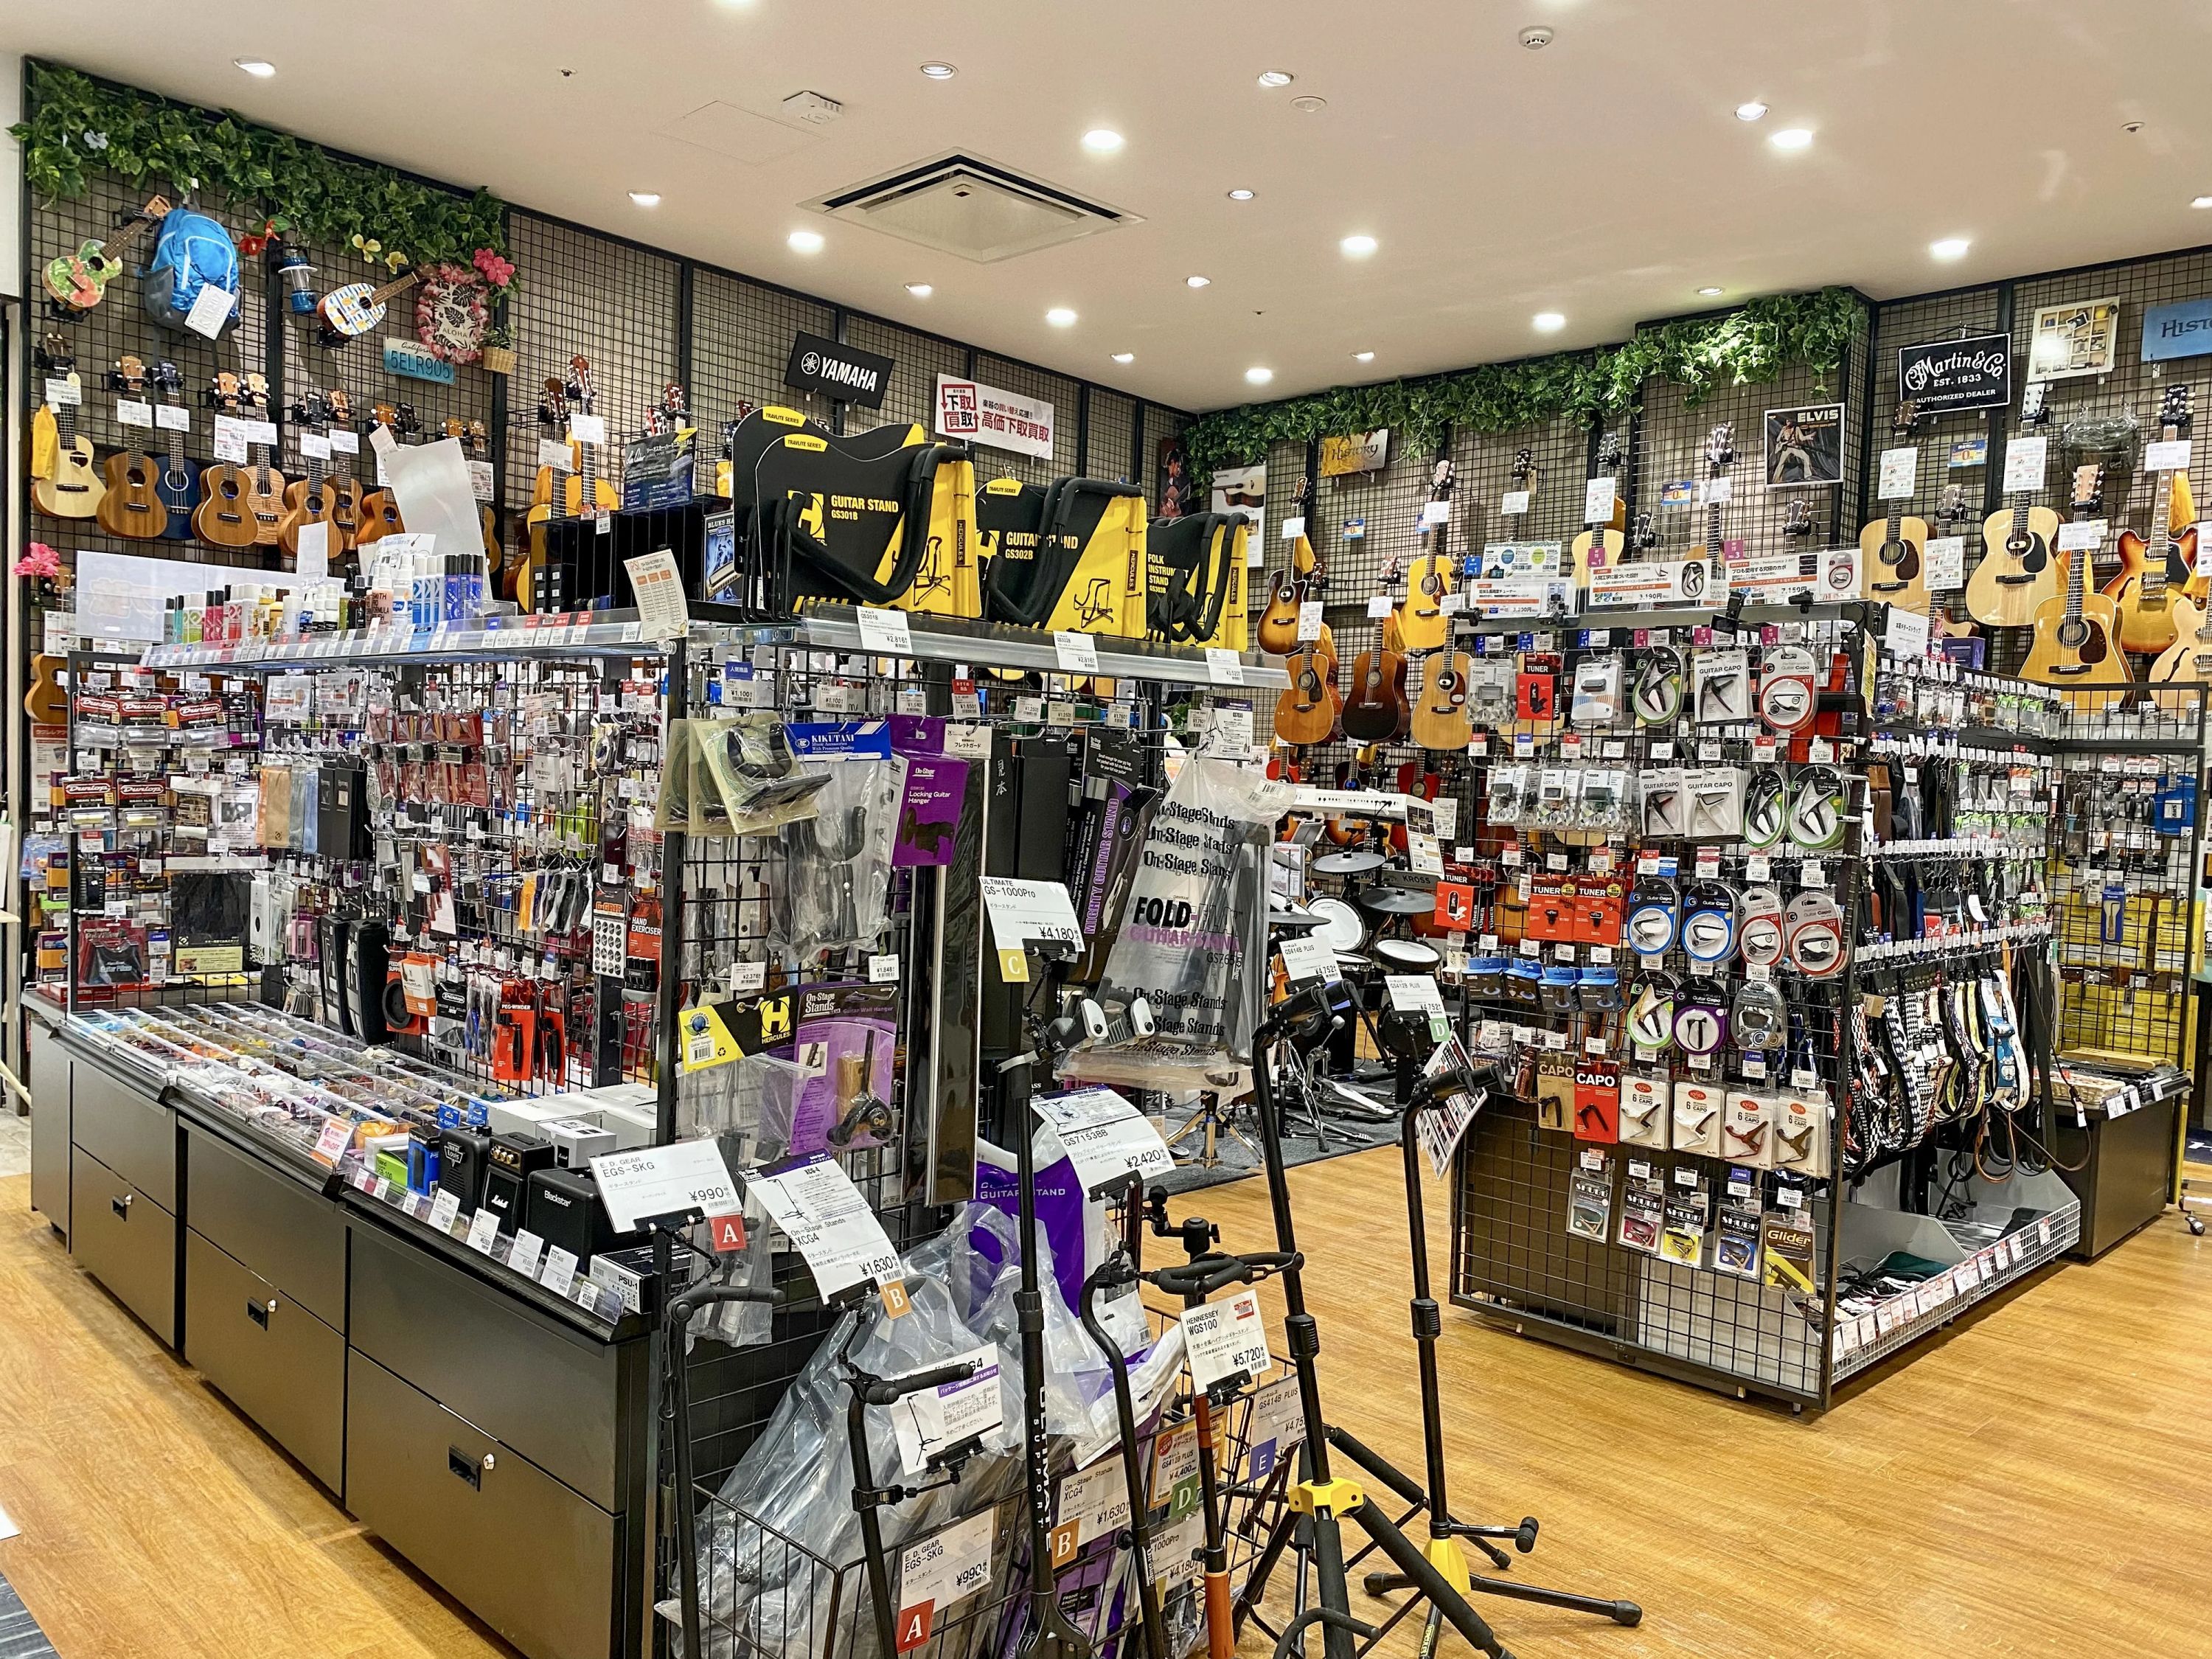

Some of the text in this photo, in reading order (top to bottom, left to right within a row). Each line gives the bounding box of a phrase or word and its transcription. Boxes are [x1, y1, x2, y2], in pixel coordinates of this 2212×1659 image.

[442, 327, 467, 338] ALOHA
[389, 350, 451, 379] 5ELR905
[820, 357, 878, 392] YAMAHA
[1933, 373, 1981, 387] EST. 1833
[947, 394, 972, 411] 下取
[1916, 389, 1996, 403] AUTHORIZED DEALER
[785, 416, 799, 424] SERIES
[949, 411, 973, 428] 買取
[1797, 409, 1839, 423] ELVIS
[982, 411, 1050, 442] 高価下取買取
[1332, 444, 1379, 460] HISTORY
[831, 495, 899, 513] GUITAR STAND
[831, 509, 858, 521] GS301B
[957, 521, 965, 563] HERCULES
[1005, 549, 1033, 560] GS302B
[1147, 553, 1164, 564] FOLK
[1129, 552, 1138, 589] HERCULES
[1148, 574, 1169, 586] STAND
[1230, 568, 1239, 603] HERCULES
[860, 613, 879, 621] GS301B
[886, 635, 905, 644] ¥2,816
[1526, 664, 1548, 673] TUNER
[1699, 666, 1723, 675] GUITAR
[731, 690, 751, 698] ¥1,100
[82, 699, 117, 710] Dunlop
[124, 702, 165, 712] Dunlop
[183, 705, 220, 714] Dunlop
[811, 734, 855, 743] KIKUTANI
[954, 741, 981, 749] フレットガード
[69, 783, 110, 793] Dunlop
[122, 785, 163, 793] Dunlop
[908, 790, 932, 800] Locking
[908, 797, 931, 805] Hanger
[1084, 798, 1119, 934] MIGHTY GUITAR STAND
[981, 878, 1014, 887] ULTIMATE
[1402, 874, 1431, 885] KROSS
[1445, 874, 1467, 884] TUNER
[984, 886, 1036, 898] GS-1000Pro
[1533, 886, 1561, 895] TUNER
[1579, 887, 1606, 897] TUNER
[632, 917, 647, 926] HAND
[631, 925, 661, 936] EXERCISER
[1039, 926, 1074, 940] ¥4,180
[1284, 946, 1303, 955] GS414B
[1008, 956, 1020, 974] C
[1315, 965, 1335, 974] ¥4,752
[805, 992, 836, 1004] On-Stage
[1190, 992, 1228, 1010] Stands
[804, 1001, 836, 1014] Stands
[1436, 1023, 1445, 1037] D
[762, 1032, 790, 1045] HERCULES
[1539, 1063, 1575, 1077] CAPO
[1576, 1072, 1615, 1088] CAPO
[1632, 1093, 1638, 1103] 6
[1686, 1101, 1691, 1110] 6
[1738, 1111, 1759, 1124] 6 CAPO
[1789, 1115, 1807, 1127] 6 CAPO
[1063, 1128, 1108, 1147] GS7153BB
[448, 1147, 461, 1164] Louis
[620, 1156, 641, 1165] GEAR
[1124, 1149, 1161, 1169] ¥2,420
[602, 1161, 655, 1178] EGS-SKG
[545, 1189, 572, 1208] Blackstar
[689, 1186, 724, 1203] ¥990
[1575, 1183, 1609, 1198] SHUBB
[1627, 1194, 1661, 1210] SHUBB
[1666, 1207, 1702, 1223] SHUBB
[1722, 1214, 1759, 1232] SHUBB
[723, 1223, 739, 1244] A
[790, 1217, 846, 1237] On-Stage Stands
[796, 1233, 820, 1247] XCG4
[1767, 1228, 1812, 1247] Glider
[858, 1255, 894, 1277] ¥1,630
[618, 1273, 639, 1290] PSU-1
[888, 1287, 904, 1309] B
[1186, 1309, 1219, 1326] HENNESSEY
[1187, 1318, 1218, 1337] WGS100
[1232, 1346, 1261, 1368] ¥5,720
[1259, 1387, 1298, 1411] GS414B PLUS
[1161, 1449, 1194, 1470] GS412B PLUS
[1258, 1454, 1267, 1472] E
[1034, 1418, 1044, 1529] SUPPORT
[1064, 1466, 1113, 1492] On-Stage Stands
[1169, 1464, 1192, 1481] ¥4,400
[1063, 1485, 1083, 1503] XCG4
[1178, 1486, 1192, 1511] D
[1096, 1501, 1126, 1526] ¥1,630
[905, 1539, 940, 1562] E. D. GEAR
[1056, 1531, 1071, 1559] B
[905, 1545, 944, 1573] EGS-SKG
[956, 1562, 983, 1587] ¥990
[1169, 1559, 1195, 1579] ¥4,180
[903, 1613, 923, 1644] A
